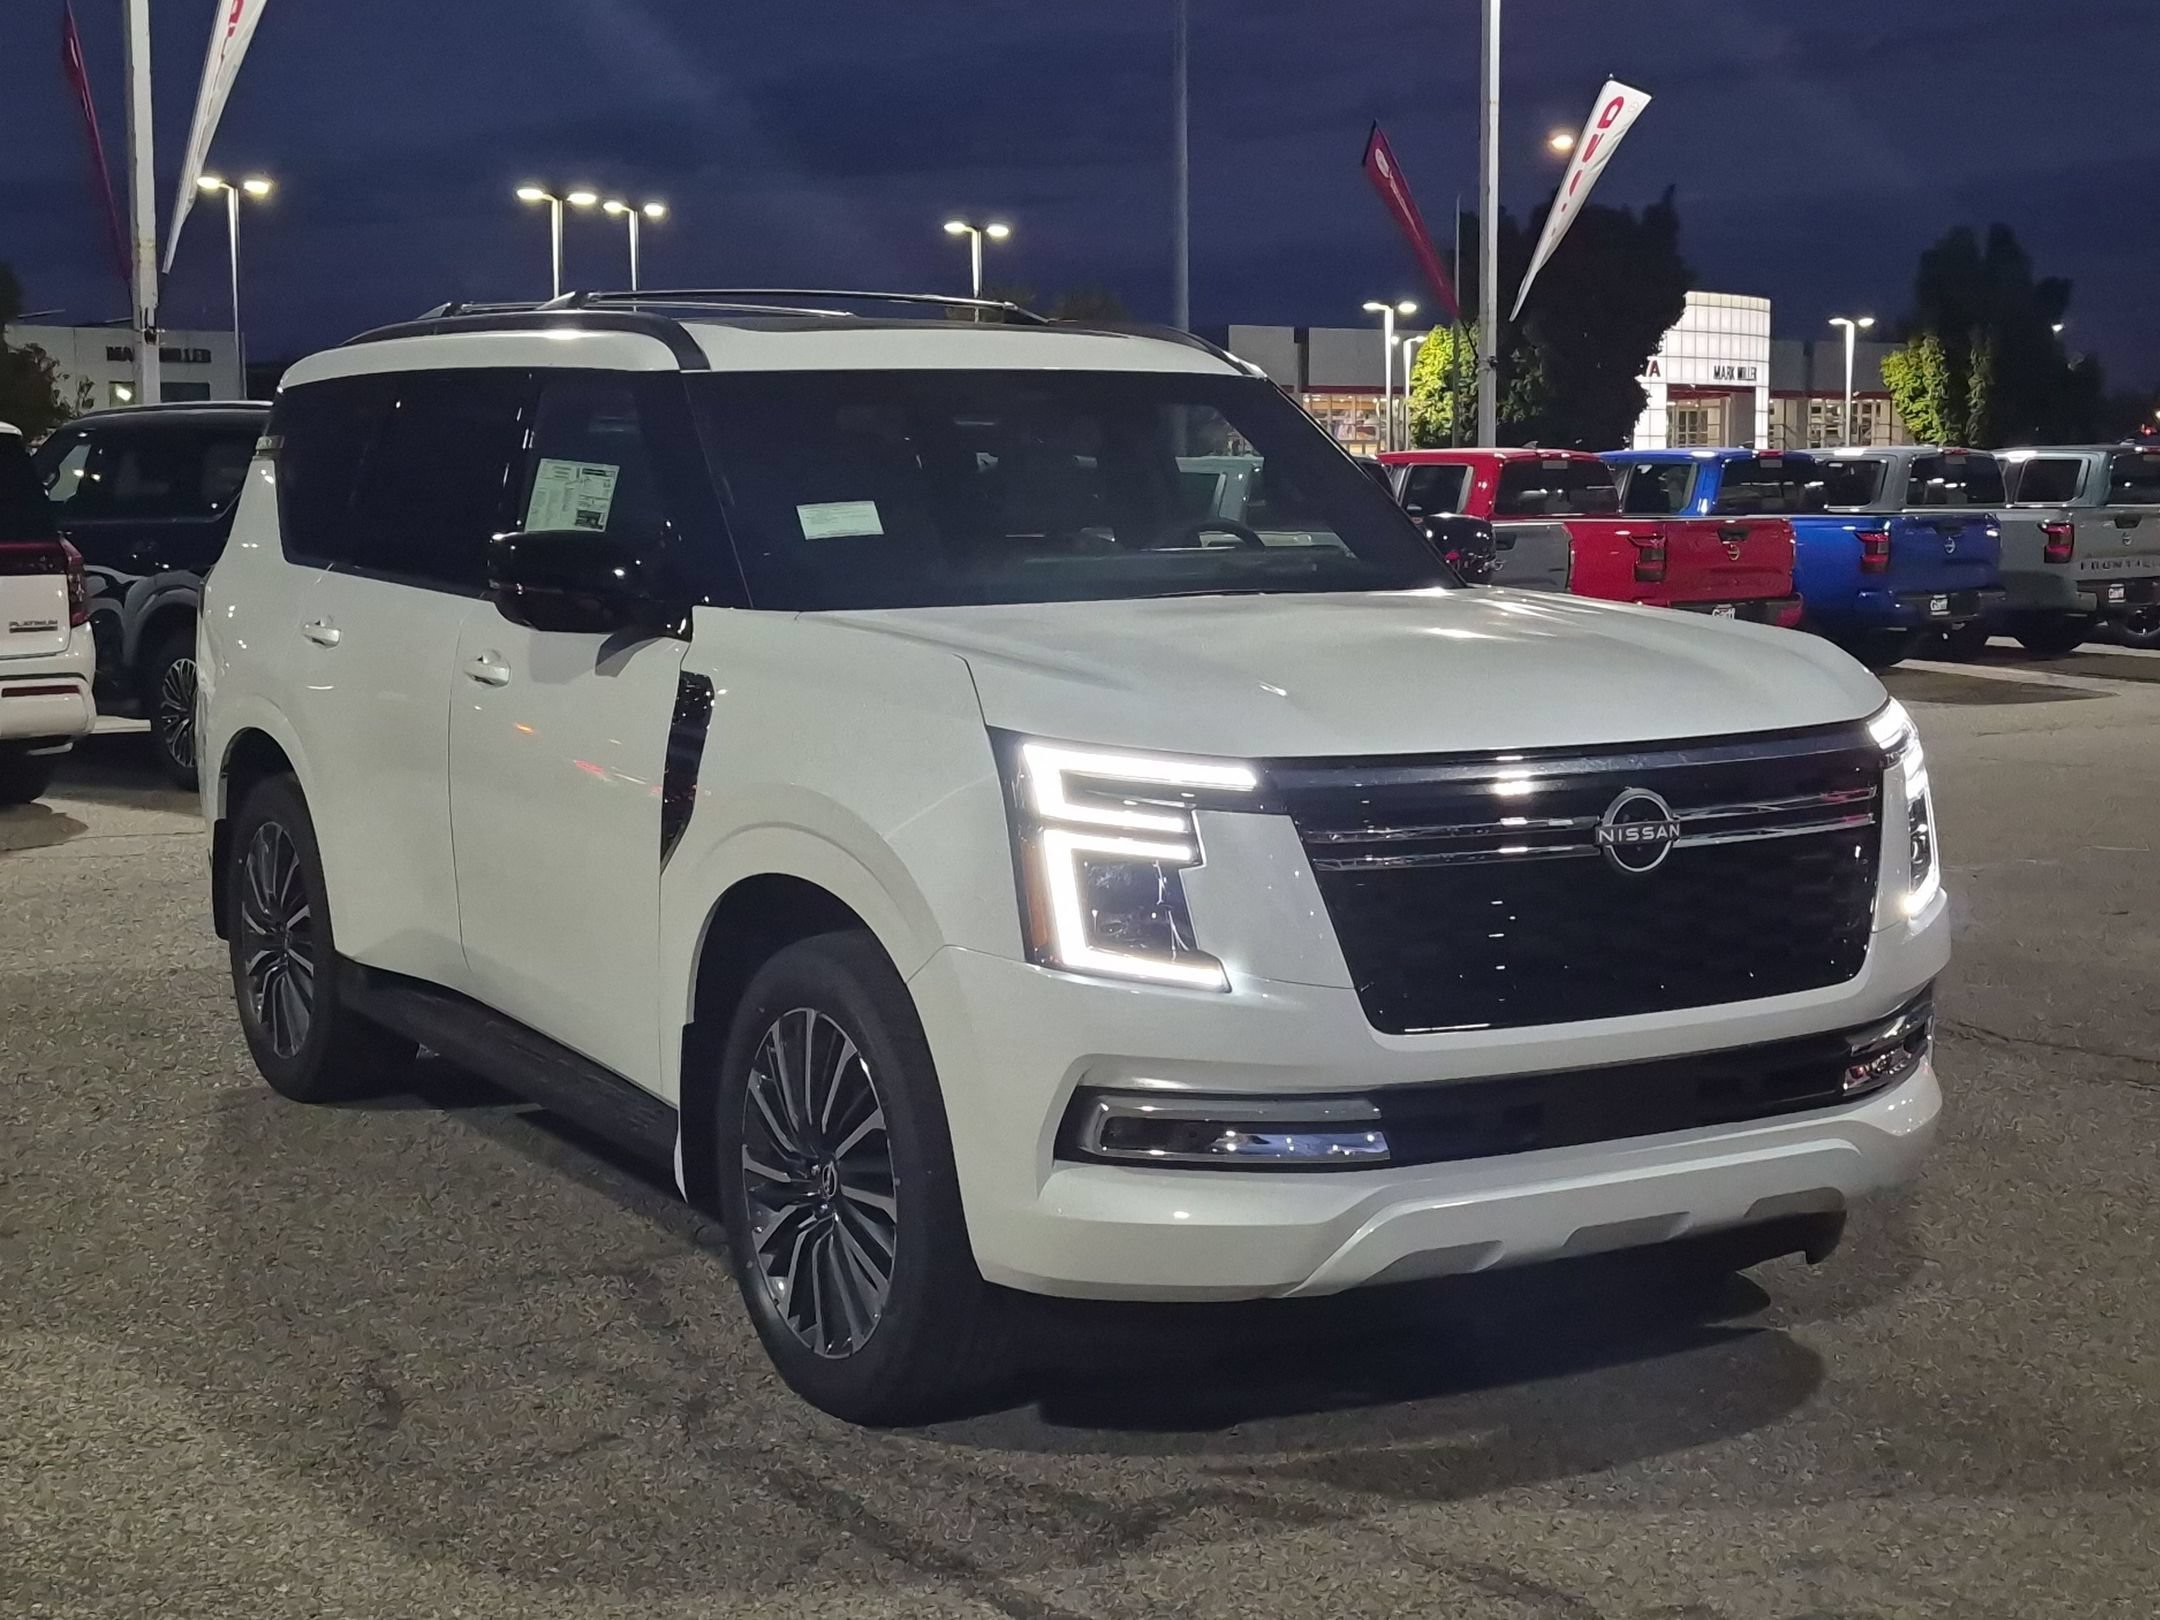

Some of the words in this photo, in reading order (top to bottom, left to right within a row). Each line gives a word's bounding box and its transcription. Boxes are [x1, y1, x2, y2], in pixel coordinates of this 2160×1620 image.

[1713, 365, 1735, 380] MARK
[1737, 366, 1757, 381] MILLER
[1599, 823, 1680, 843] NISSAN
